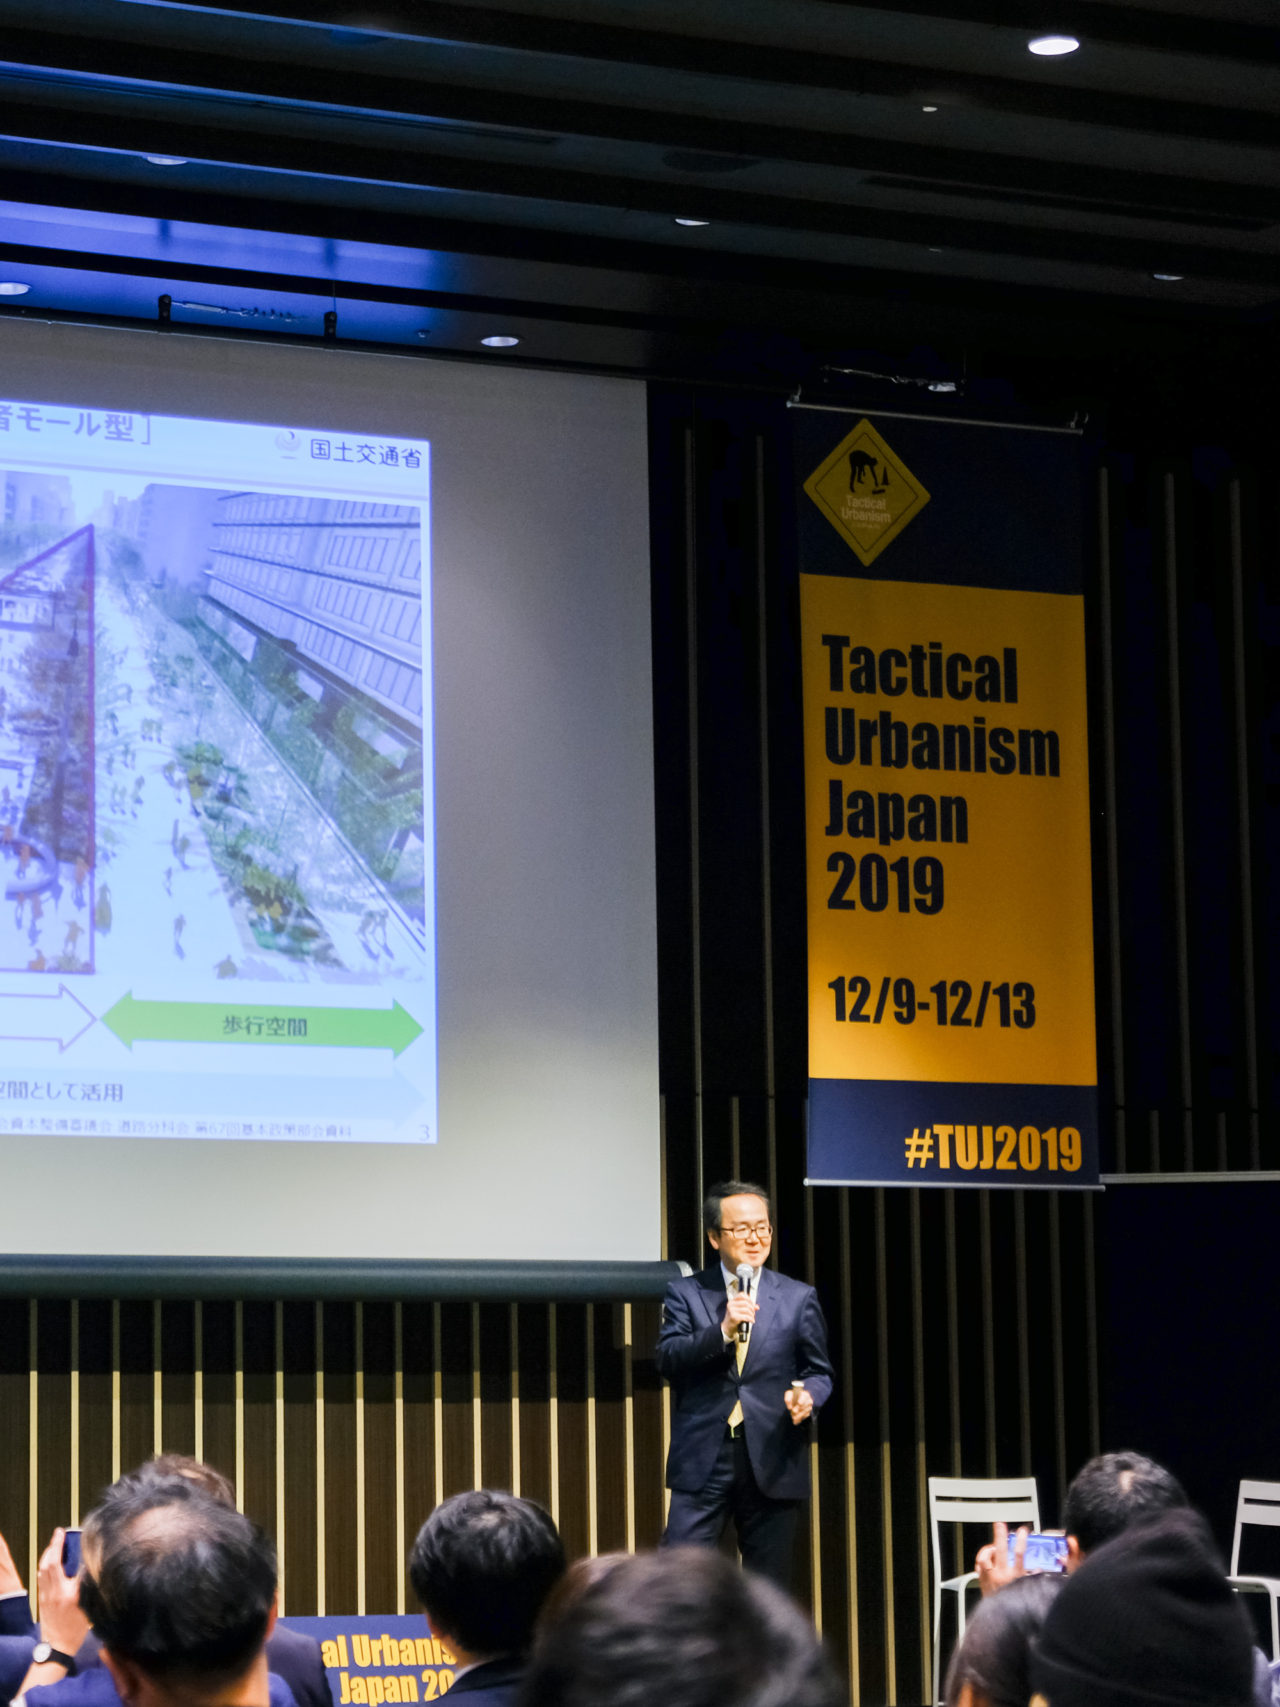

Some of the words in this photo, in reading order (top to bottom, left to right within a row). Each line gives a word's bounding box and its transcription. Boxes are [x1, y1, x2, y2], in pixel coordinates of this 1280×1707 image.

[310, 438, 423, 469] 国土交通省
[841, 507, 892, 523] Urbanism
[846, 495, 887, 511] Tactical
[821, 634, 1019, 704] Tactical
[824, 706, 1060, 777] Urbanism
[825, 779, 969, 846] Japan
[826, 851, 945, 915] 2019
[828, 976, 1037, 1029] 12/9-12/13
[222, 1015, 308, 1037] 歩行空間
[418, 1125, 430, 1141] 3
[905, 1124, 1082, 1172] #TUJ2019
[321, 1635, 349, 1668] al
[339, 1672, 419, 1707] Japan
[421, 1669, 455, 1702] 20
